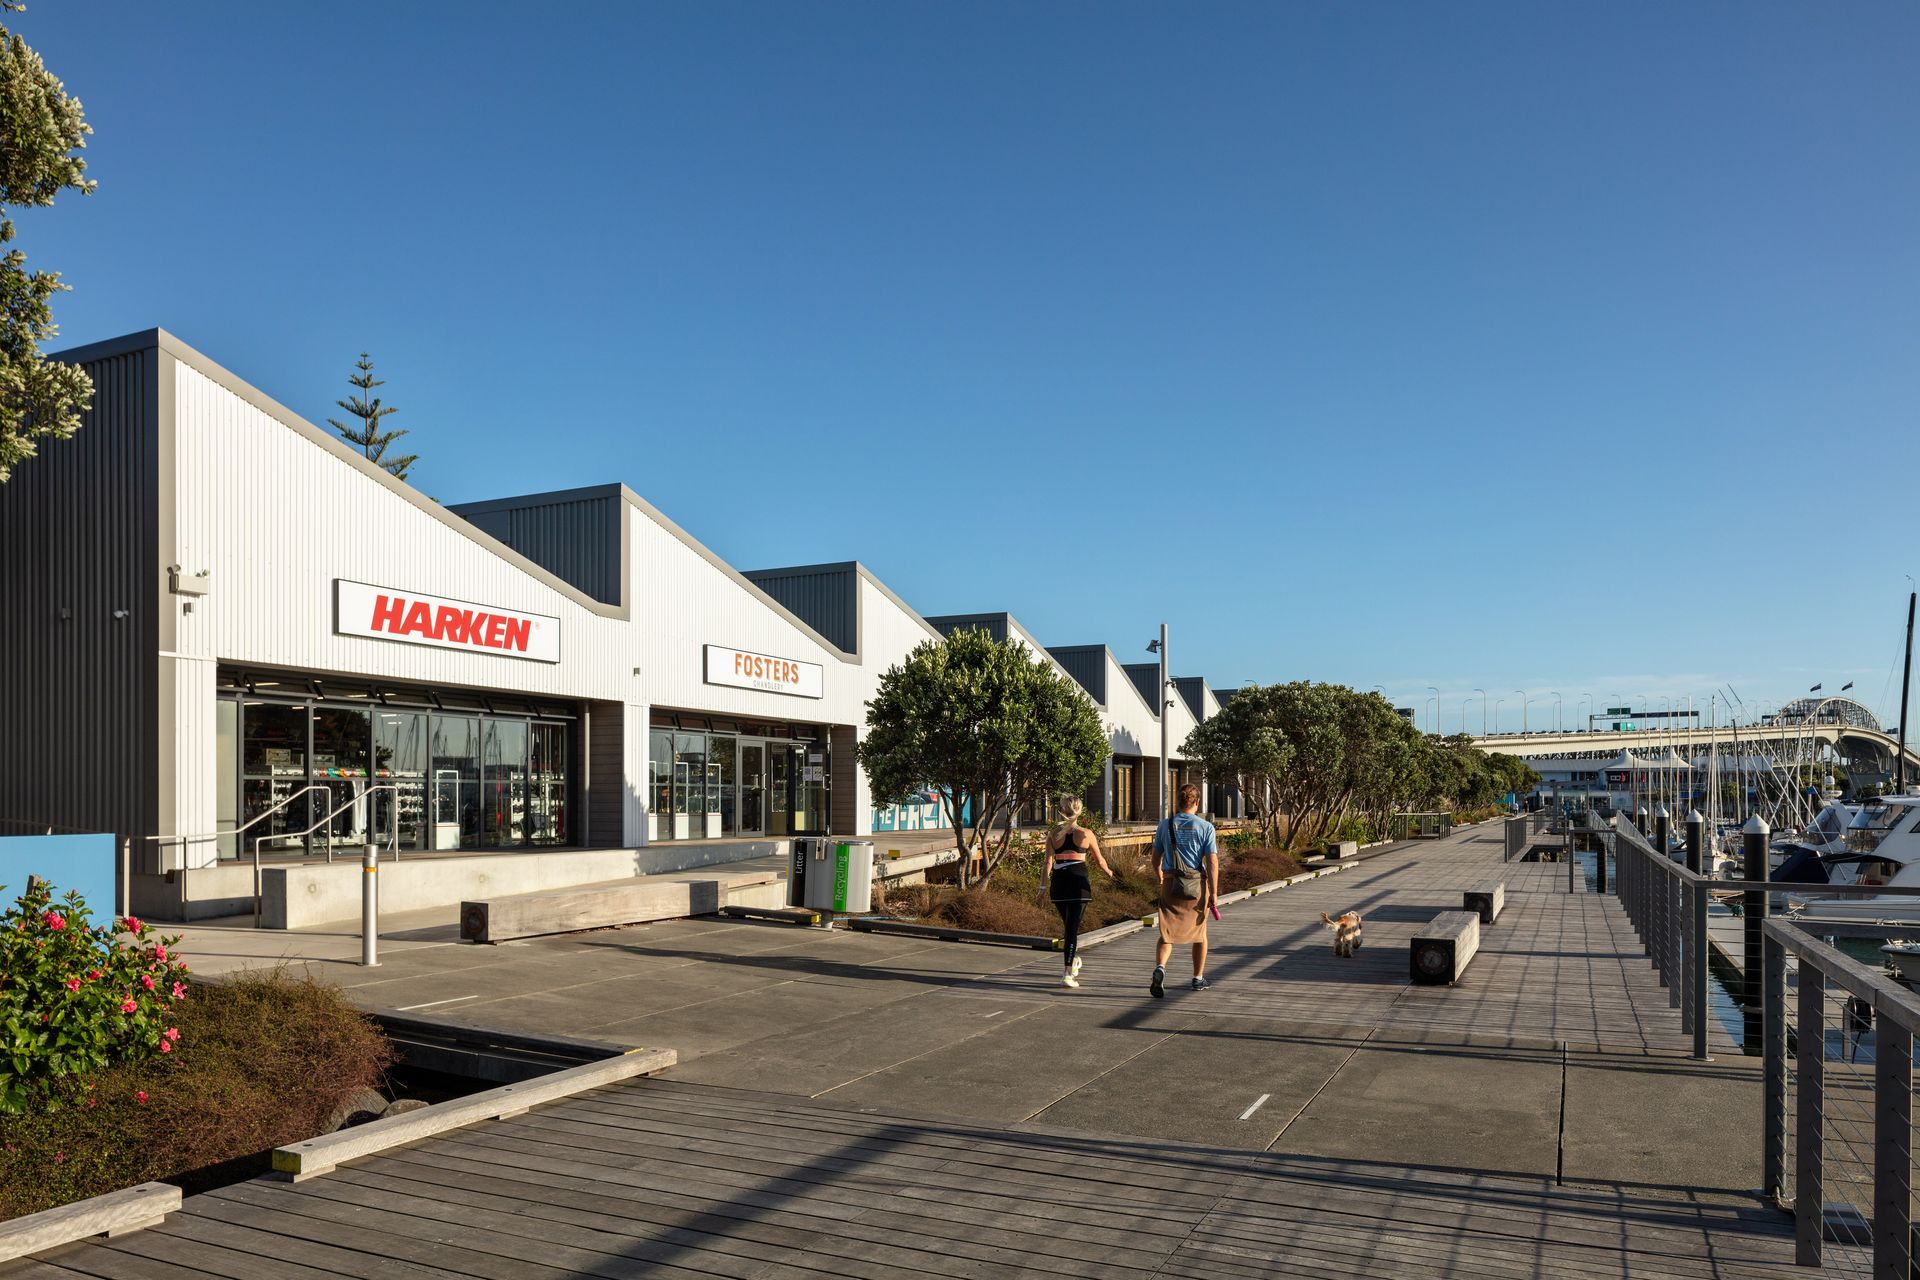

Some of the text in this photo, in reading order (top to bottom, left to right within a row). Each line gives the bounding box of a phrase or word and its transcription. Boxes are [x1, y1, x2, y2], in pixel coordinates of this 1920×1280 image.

[370, 594, 531, 652] HARKEN
[734, 653, 800, 685] FOSTERS
[795, 851, 804, 874] Litter
[835, 856, 848, 901] Recycling
